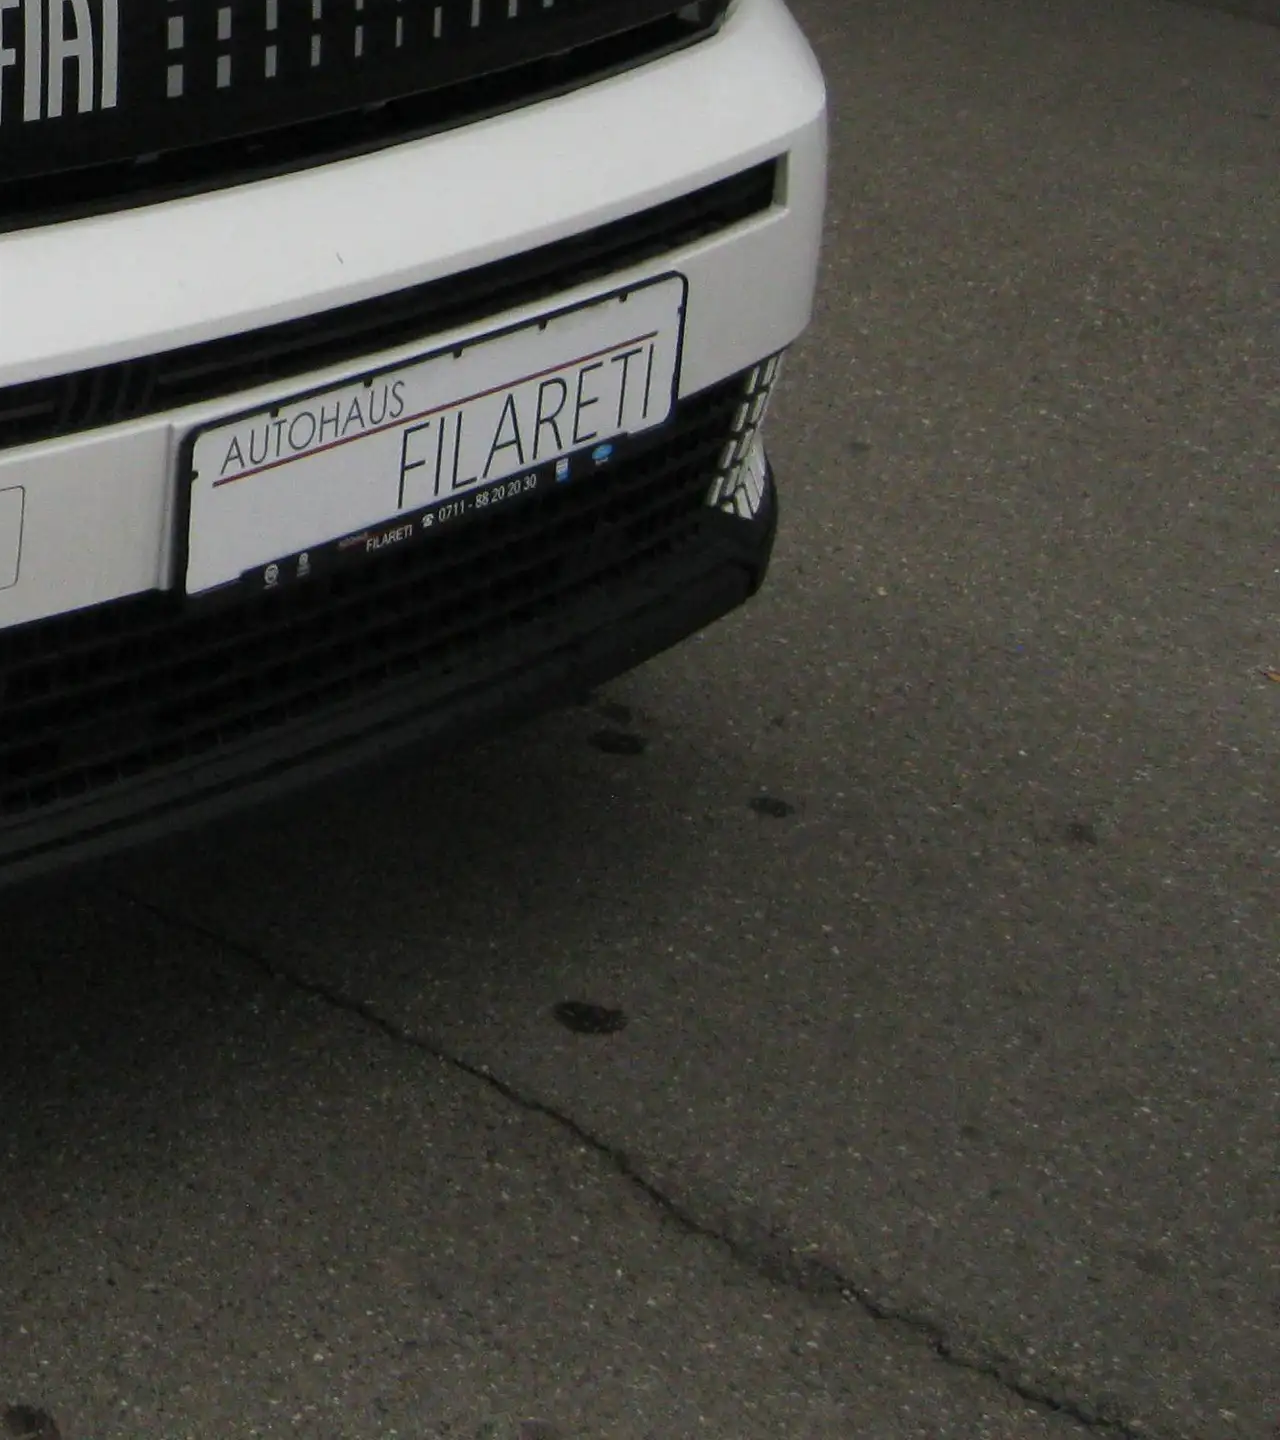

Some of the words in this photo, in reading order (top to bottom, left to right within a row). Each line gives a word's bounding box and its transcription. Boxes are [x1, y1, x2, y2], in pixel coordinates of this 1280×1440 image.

[219, 380, 406, 475] AUTOHAUS
[396, 343, 655, 509] FILARETI
[365, 524, 413, 553] FILARETI
[438, 499, 465, 522] 0711
[475, 491, 490, 509] 88
[491, 485, 505, 503] 20
[507, 479, 521, 497] 20
[523, 473, 537, 491] 30
